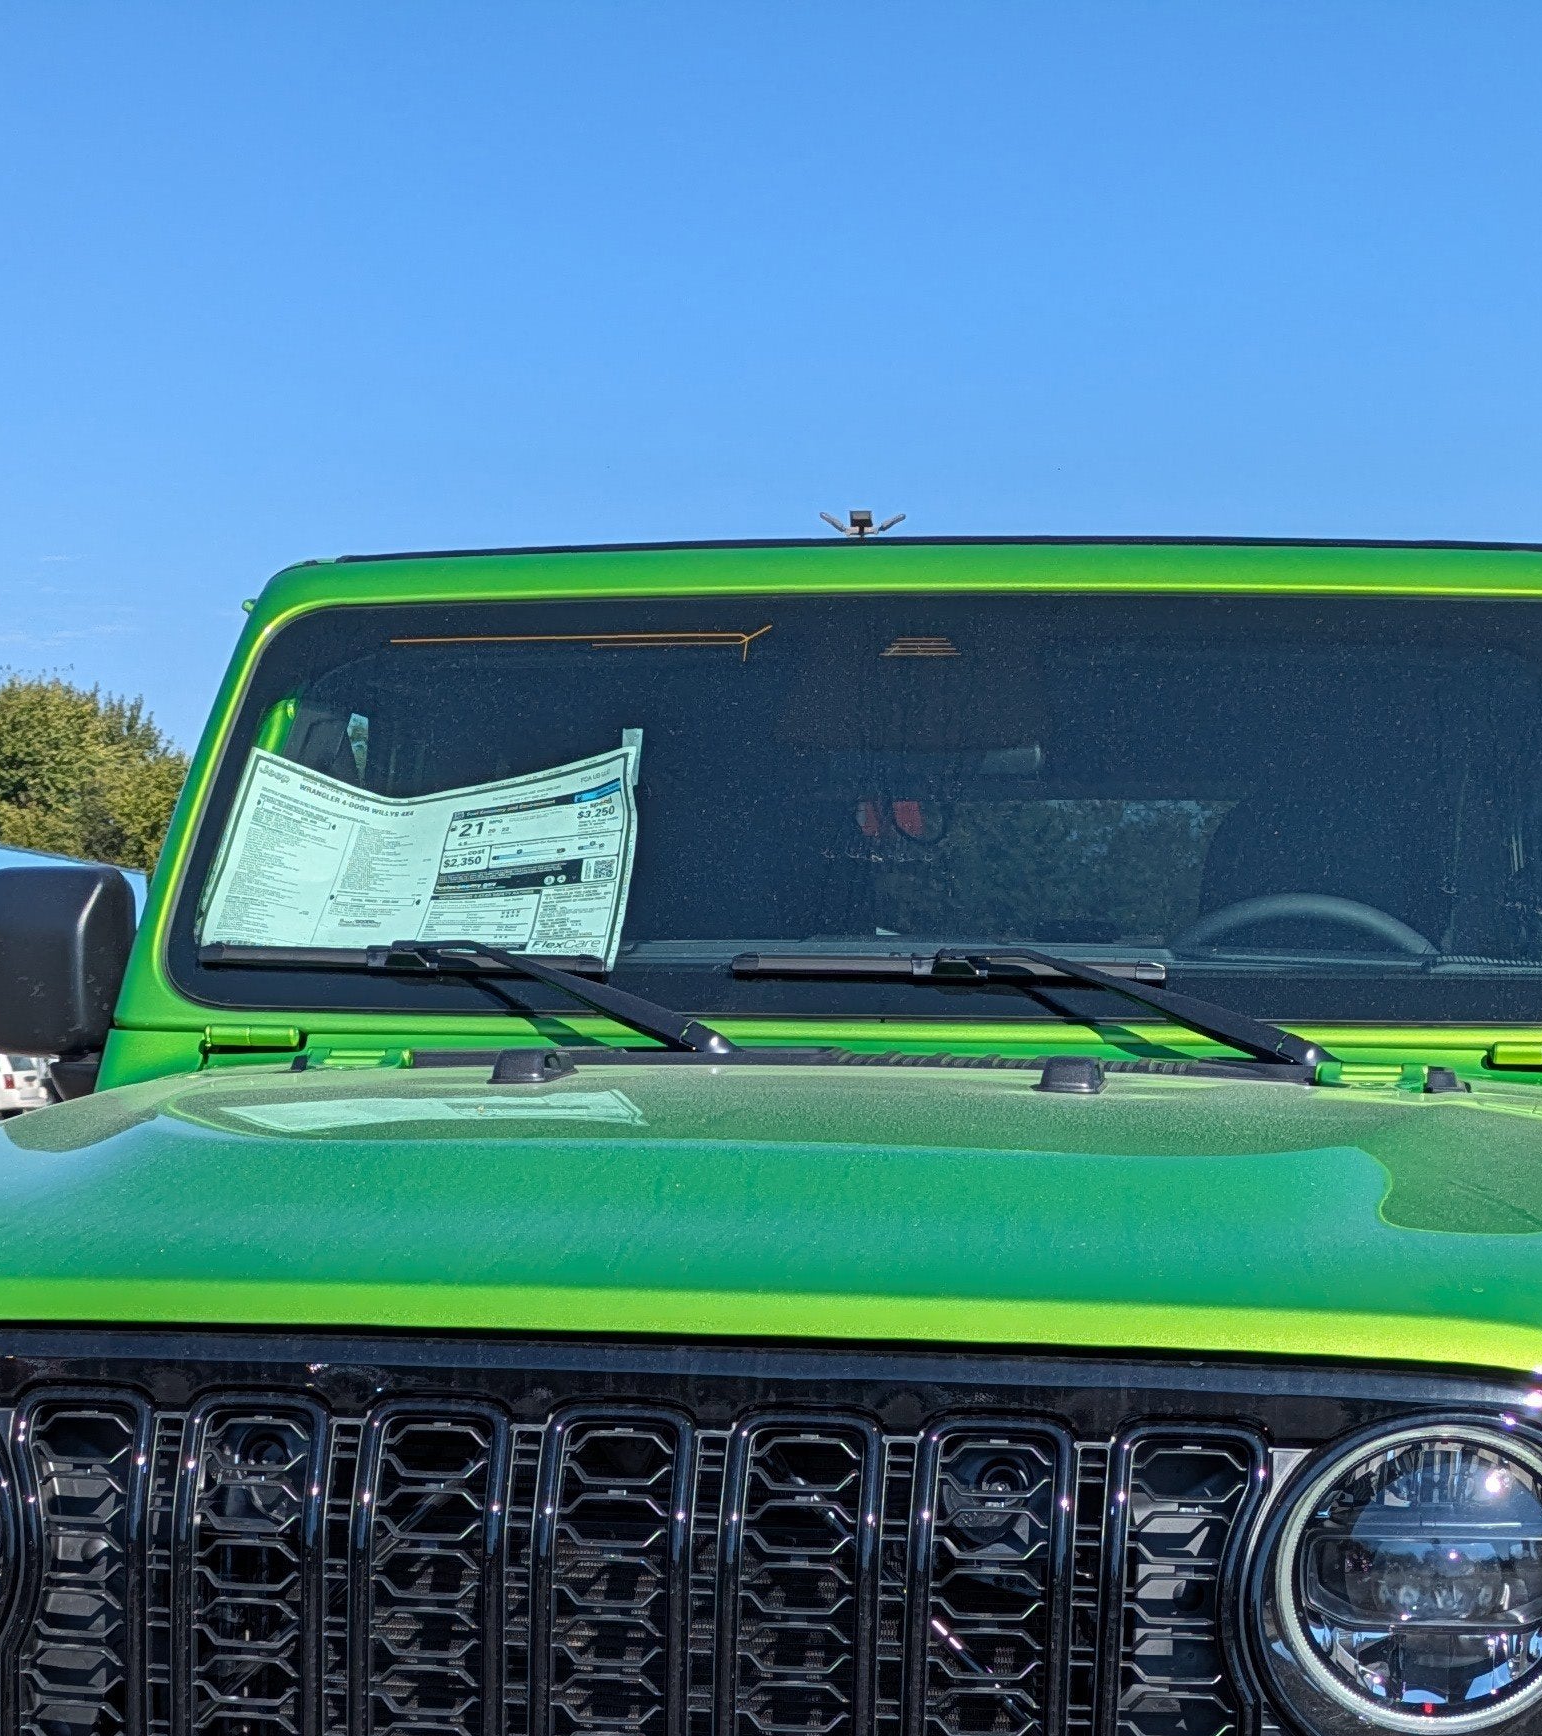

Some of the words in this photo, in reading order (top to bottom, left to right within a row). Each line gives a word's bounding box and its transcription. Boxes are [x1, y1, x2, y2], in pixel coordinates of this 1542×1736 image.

[299, 783, 341, 804] WRANGLER
[341, 800, 370, 813] 4-DOOR
[371, 807, 400, 818] WILLYS
[577, 805, 615, 819] $3,250
[459, 821, 485, 837] 21
[443, 856, 482, 868] $2,350
[532, 939, 601, 949] FlexCare
